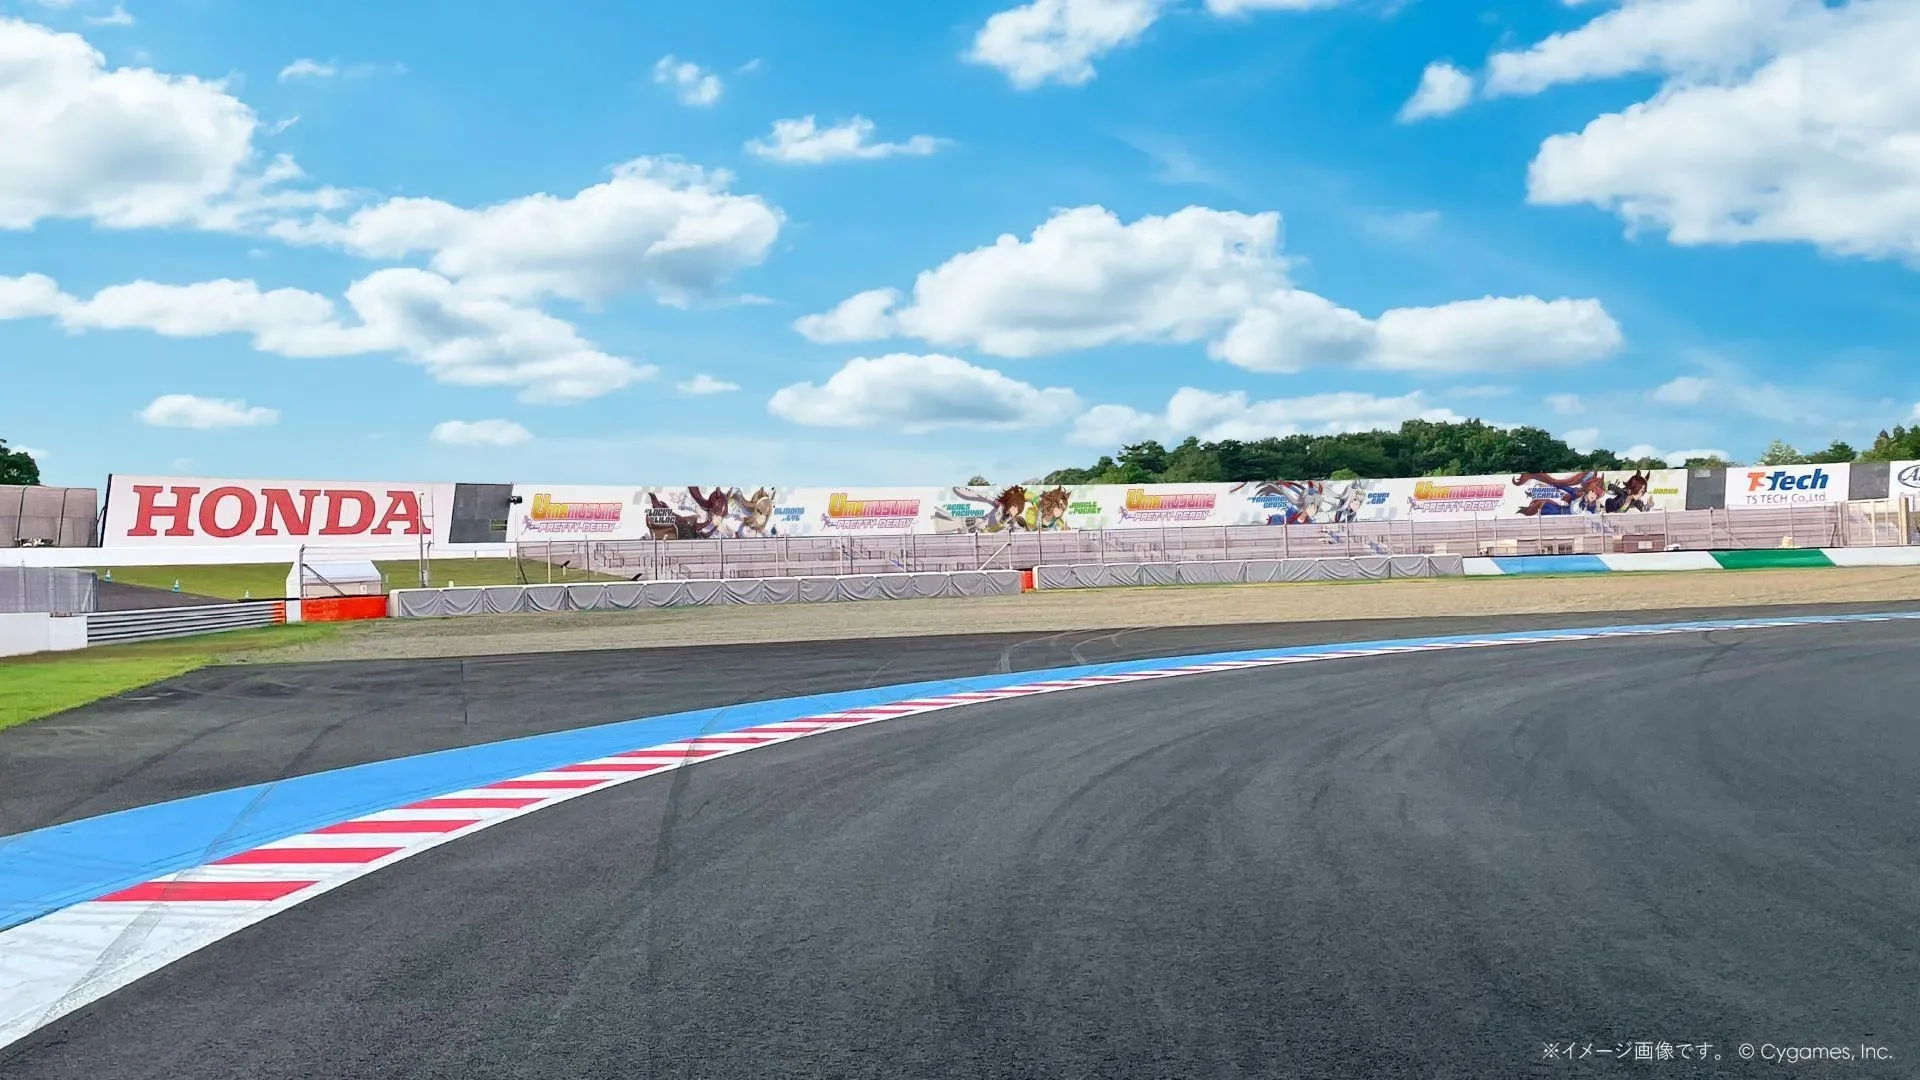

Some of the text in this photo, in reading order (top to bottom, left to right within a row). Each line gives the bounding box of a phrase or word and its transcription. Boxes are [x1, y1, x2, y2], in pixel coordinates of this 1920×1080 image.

[1746, 495, 1757, 504] TS
[1760, 494, 1787, 503] TECH
[127, 485, 432, 538] HONDA
[1422, 500, 1499, 513] PRETTY DERBY
[1132, 510, 1210, 522] PRETTY DERBY
[538, 522, 616, 532] PRETTY DERBY
[835, 518, 913, 530] PRETTY DERBY
